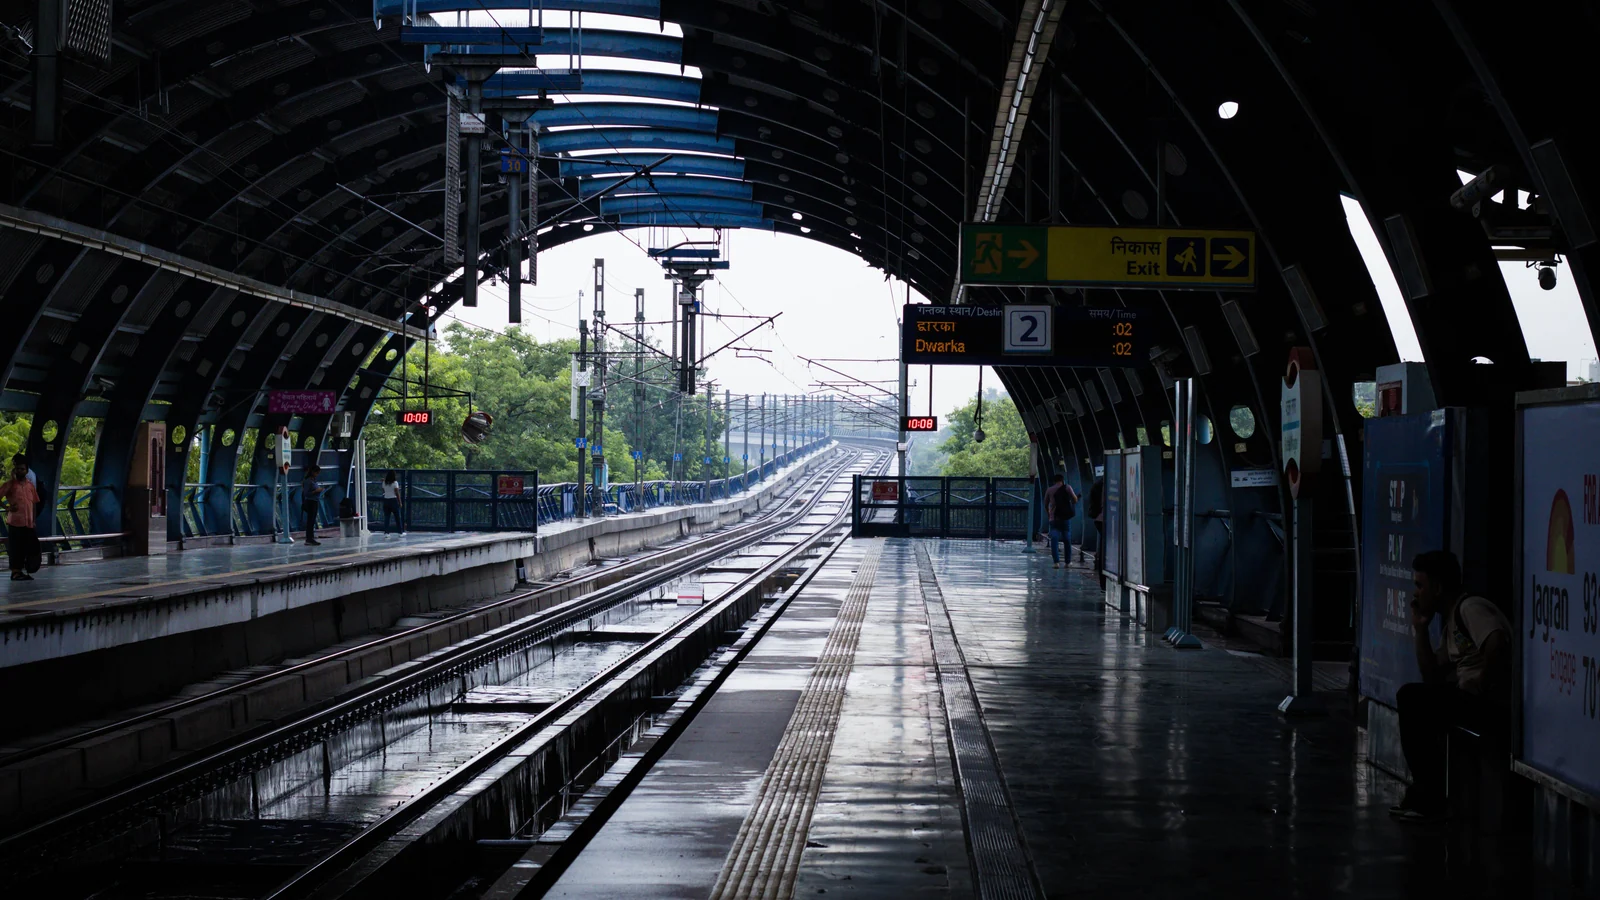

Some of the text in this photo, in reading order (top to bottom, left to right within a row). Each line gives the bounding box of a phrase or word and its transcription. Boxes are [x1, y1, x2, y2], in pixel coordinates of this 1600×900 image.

[507, 160, 521, 172] 30
[1110, 236, 1161, 255] निकास
[1127, 261, 1160, 275] Exit
[918, 306, 946, 315] गन्तव्य
[917, 321, 957, 332] द्वारका
[1020, 315, 1038, 341] 2
[1112, 322, 1132, 336] :02
[915, 338, 966, 353] Dwarka
[1112, 342, 1132, 356] :02
[403, 413, 428, 423] 10:08
[908, 419, 933, 429] 10:08
[1584, 474, 1597, 525] FOR
[1530, 574, 1569, 642] Jagran
[1583, 572, 1600, 635] 93
[1551, 637, 1576, 696] Engage
[1583, 656, 1600, 720] 70
